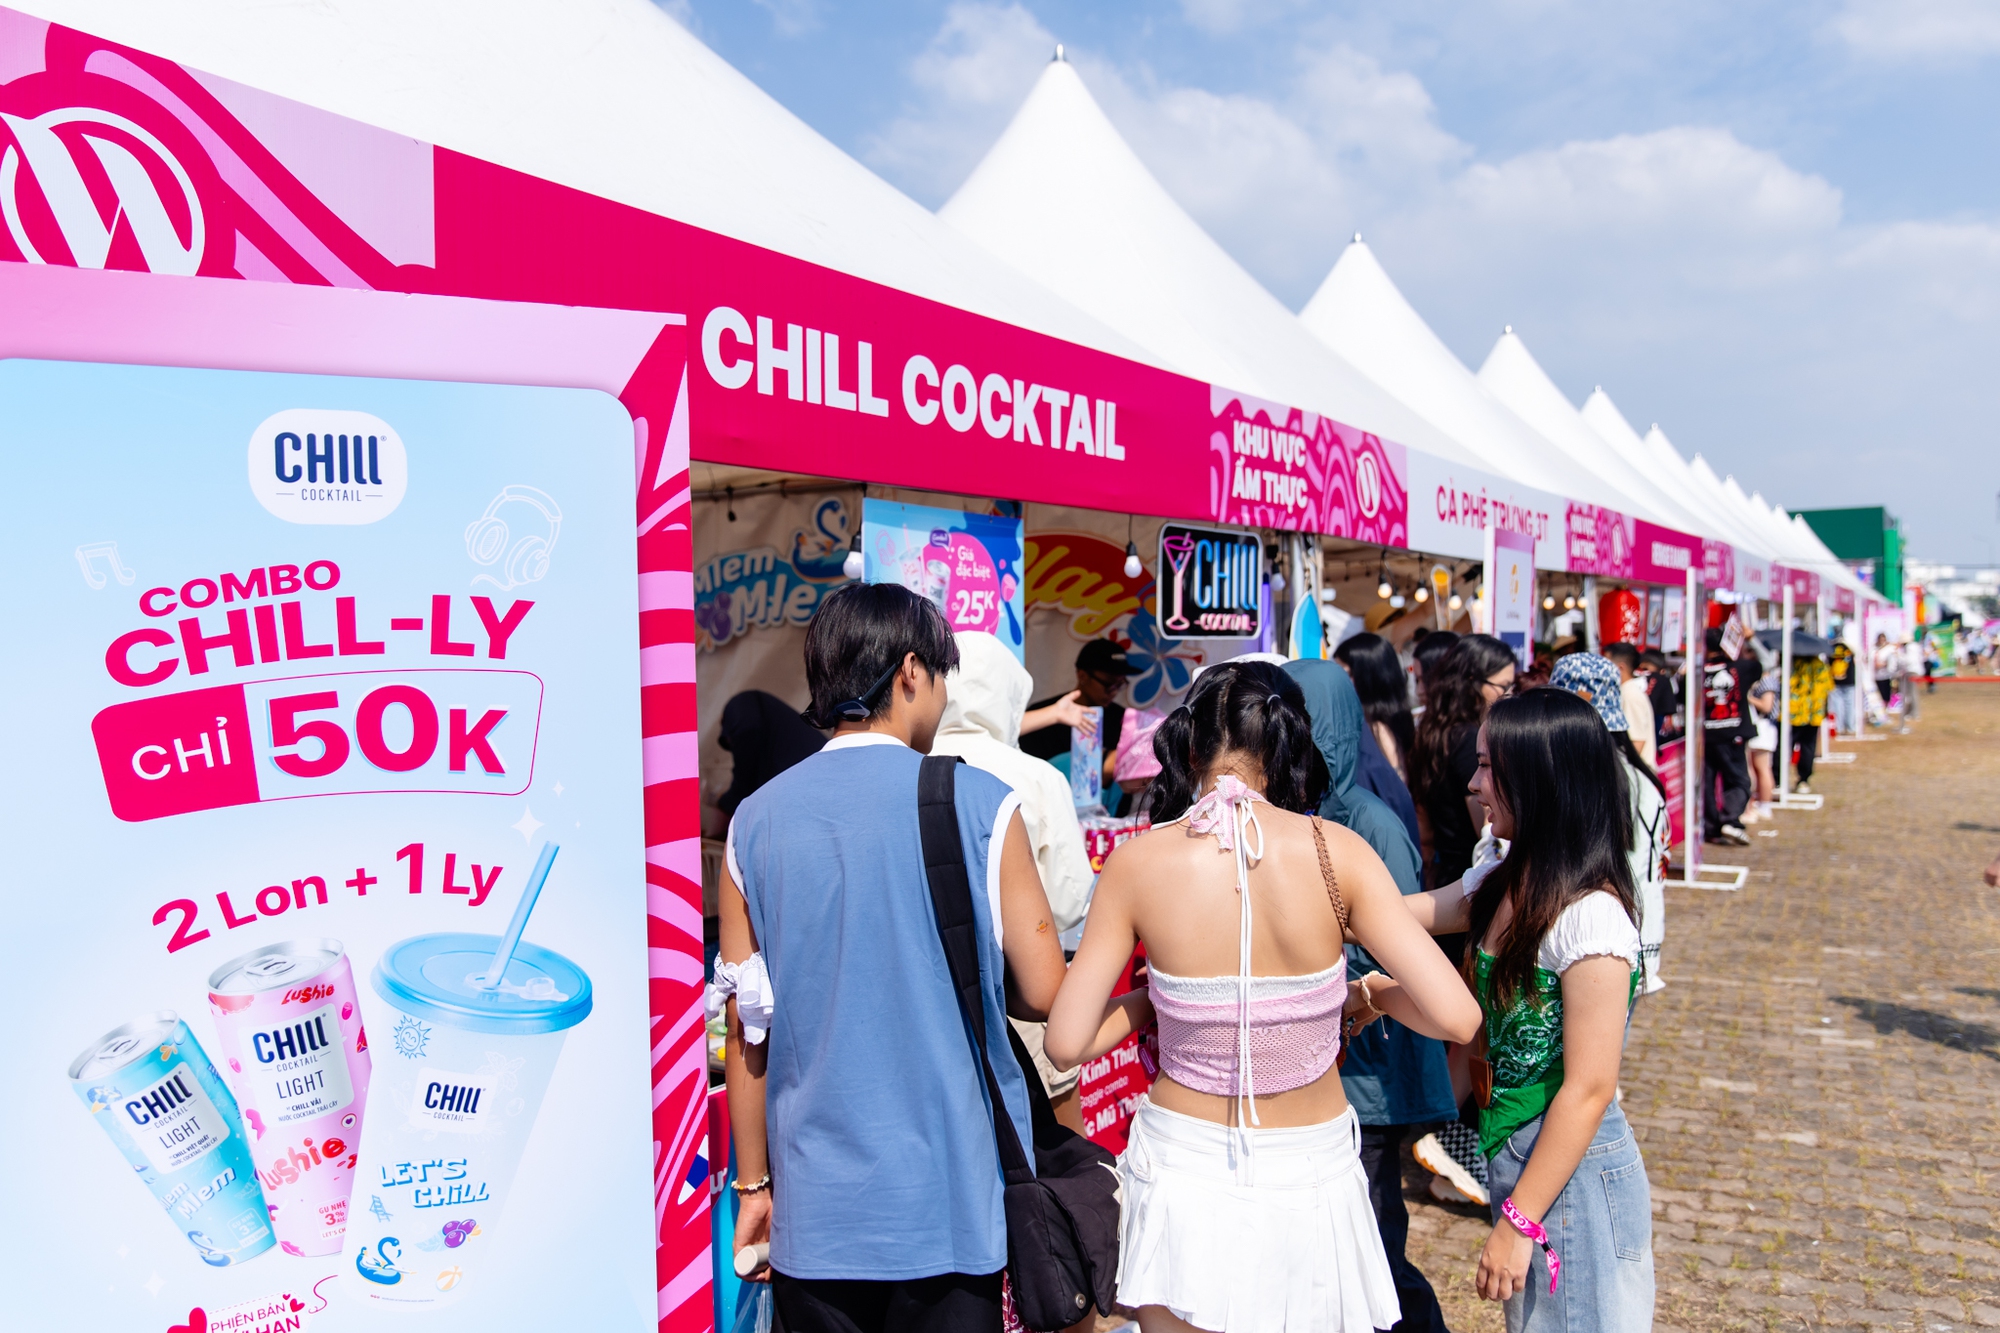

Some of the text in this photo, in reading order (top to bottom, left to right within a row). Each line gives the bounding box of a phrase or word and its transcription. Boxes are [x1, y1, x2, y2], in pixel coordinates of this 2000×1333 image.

[701, 306, 1125, 461] CHILL COCKTAIL
[273, 431, 383, 485] CHILL
[1233, 420, 1306, 472] KHU VỰC
[300, 487, 363, 502] COCKTAIL
[1262, 470, 1308, 514] THỰC
[1436, 477, 1458, 525] CÀ
[139, 560, 341, 618] COMBO
[1194, 539, 1258, 610] CHILL
[731, 574, 834, 633] Mle
[954, 589, 995, 625] 25K
[104, 594, 536, 688] CHILL-LY
[131, 684, 510, 781] CHỈ 50K
[152, 898, 211, 955] 2
[216, 873, 329, 930] Lon
[396, 842, 425, 895] 1
[442, 852, 504, 908] Ly
[252, 1015, 329, 1063] CHILL
[276, 1054, 319, 1073] COCKTAIL
[276, 1070, 325, 1099] LIGHT
[125, 1074, 193, 1125] CHILL
[154, 1106, 188, 1129] COCKTAIL
[291, 1102, 310, 1112] CHILL
[425, 1082, 481, 1113] CHILL
[433, 1111, 464, 1122] COCKTAIL
[158, 1116, 201, 1149] LIGHT
[379, 1158, 467, 1188] LET'S
[318, 1206, 330, 1214] GU
[210, 1302, 286, 1333] PHIÊN BẢN
